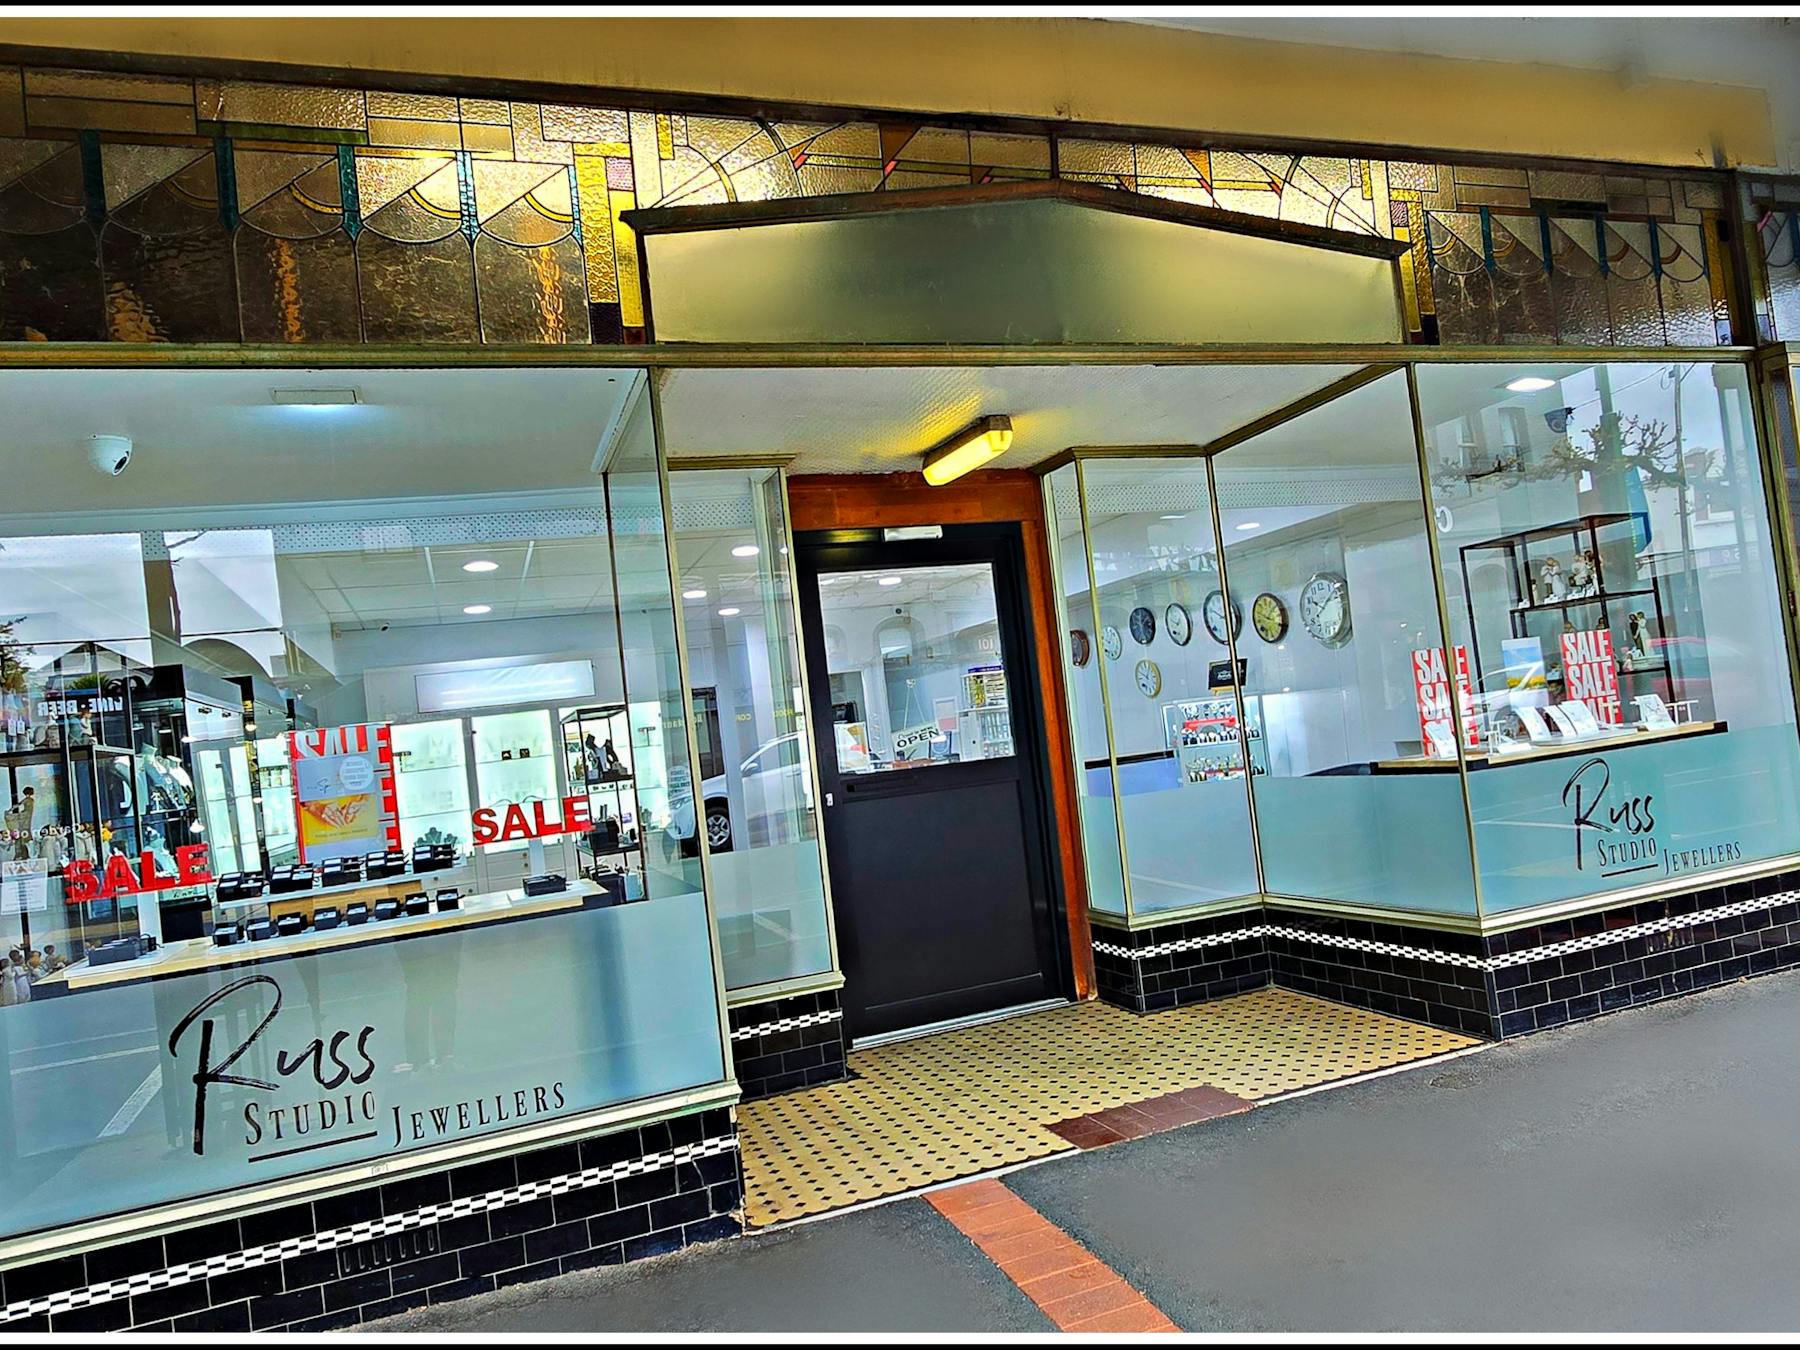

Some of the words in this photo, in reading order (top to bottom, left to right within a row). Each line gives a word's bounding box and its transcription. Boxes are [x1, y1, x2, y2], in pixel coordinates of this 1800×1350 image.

[1415, 645, 1468, 684] SAE
[1562, 631, 1610, 666] SALE
[1419, 679, 1474, 721] SAE
[1567, 661, 1616, 700] SALE
[897, 728, 940, 748] OPEN
[471, 795, 594, 846] SALE
[1562, 757, 1655, 871] Russ
[63, 842, 213, 904] SALE
[1597, 837, 1657, 867] STUDIO
[1663, 841, 1742, 876] JEWELLERS
[168, 974, 376, 1156] Russ
[244, 1090, 375, 1146] STUDIO
[391, 1081, 566, 1148] JEWELLERS
